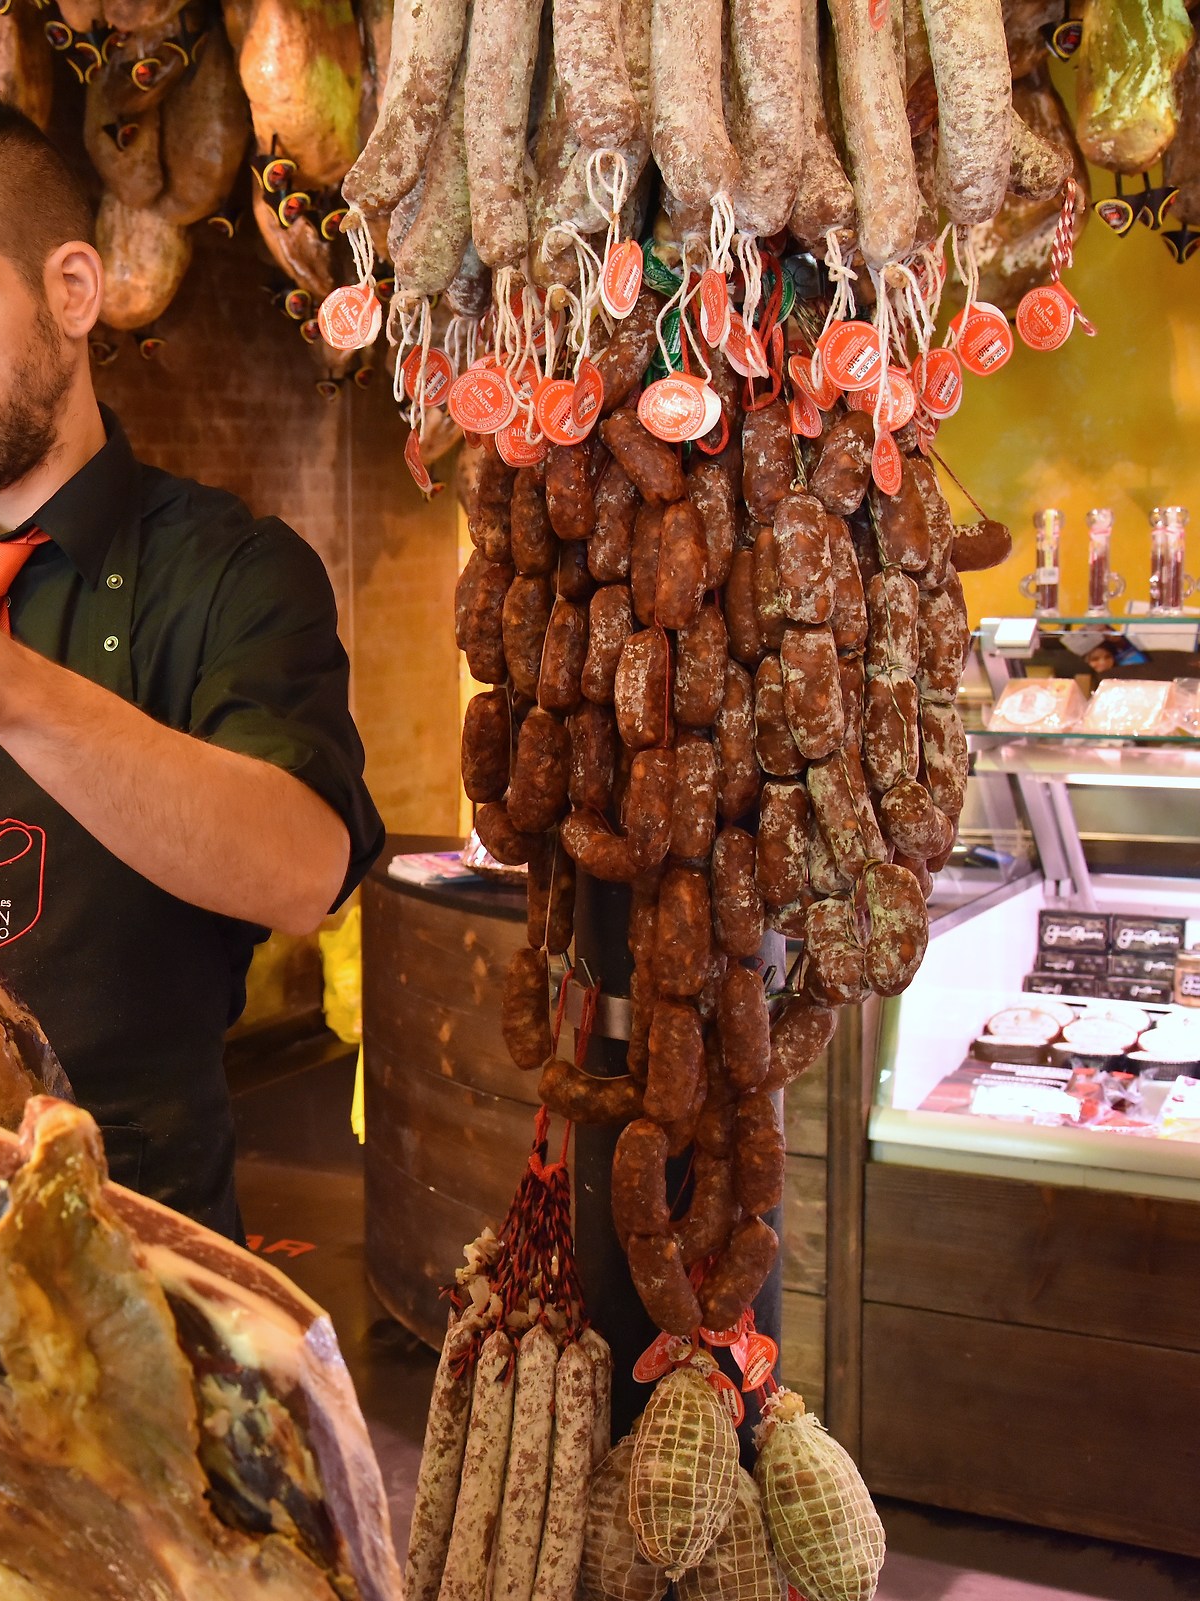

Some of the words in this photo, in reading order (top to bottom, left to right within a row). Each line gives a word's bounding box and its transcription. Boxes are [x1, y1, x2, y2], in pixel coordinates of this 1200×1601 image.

[339, 302, 358, 331] Alberca
[350, 304, 359, 317] La
[1033, 302, 1054, 331] Alberca
[1045, 304, 1054, 317] La
[960, 317, 990, 346] INGREDIENTES
[1041, 334, 1060, 347] BELLOTA
[826, 326, 856, 365] INGREDIENTES
[975, 339, 996, 360] LOTE-11
[844, 348, 866, 373] LOTE-11
[483, 373, 501, 384] CERDO
[469, 383, 494, 413] Alberca
[484, 386, 494, 399] La
[541, 385, 566, 419] INGREDIENTES
[671, 392, 682, 403] La
[499, 403, 508, 418] EXTRA
[656, 396, 688, 417] Alberca
[477, 416, 499, 429] BELLOTA
[680, 417, 700, 436] BELLOTA
